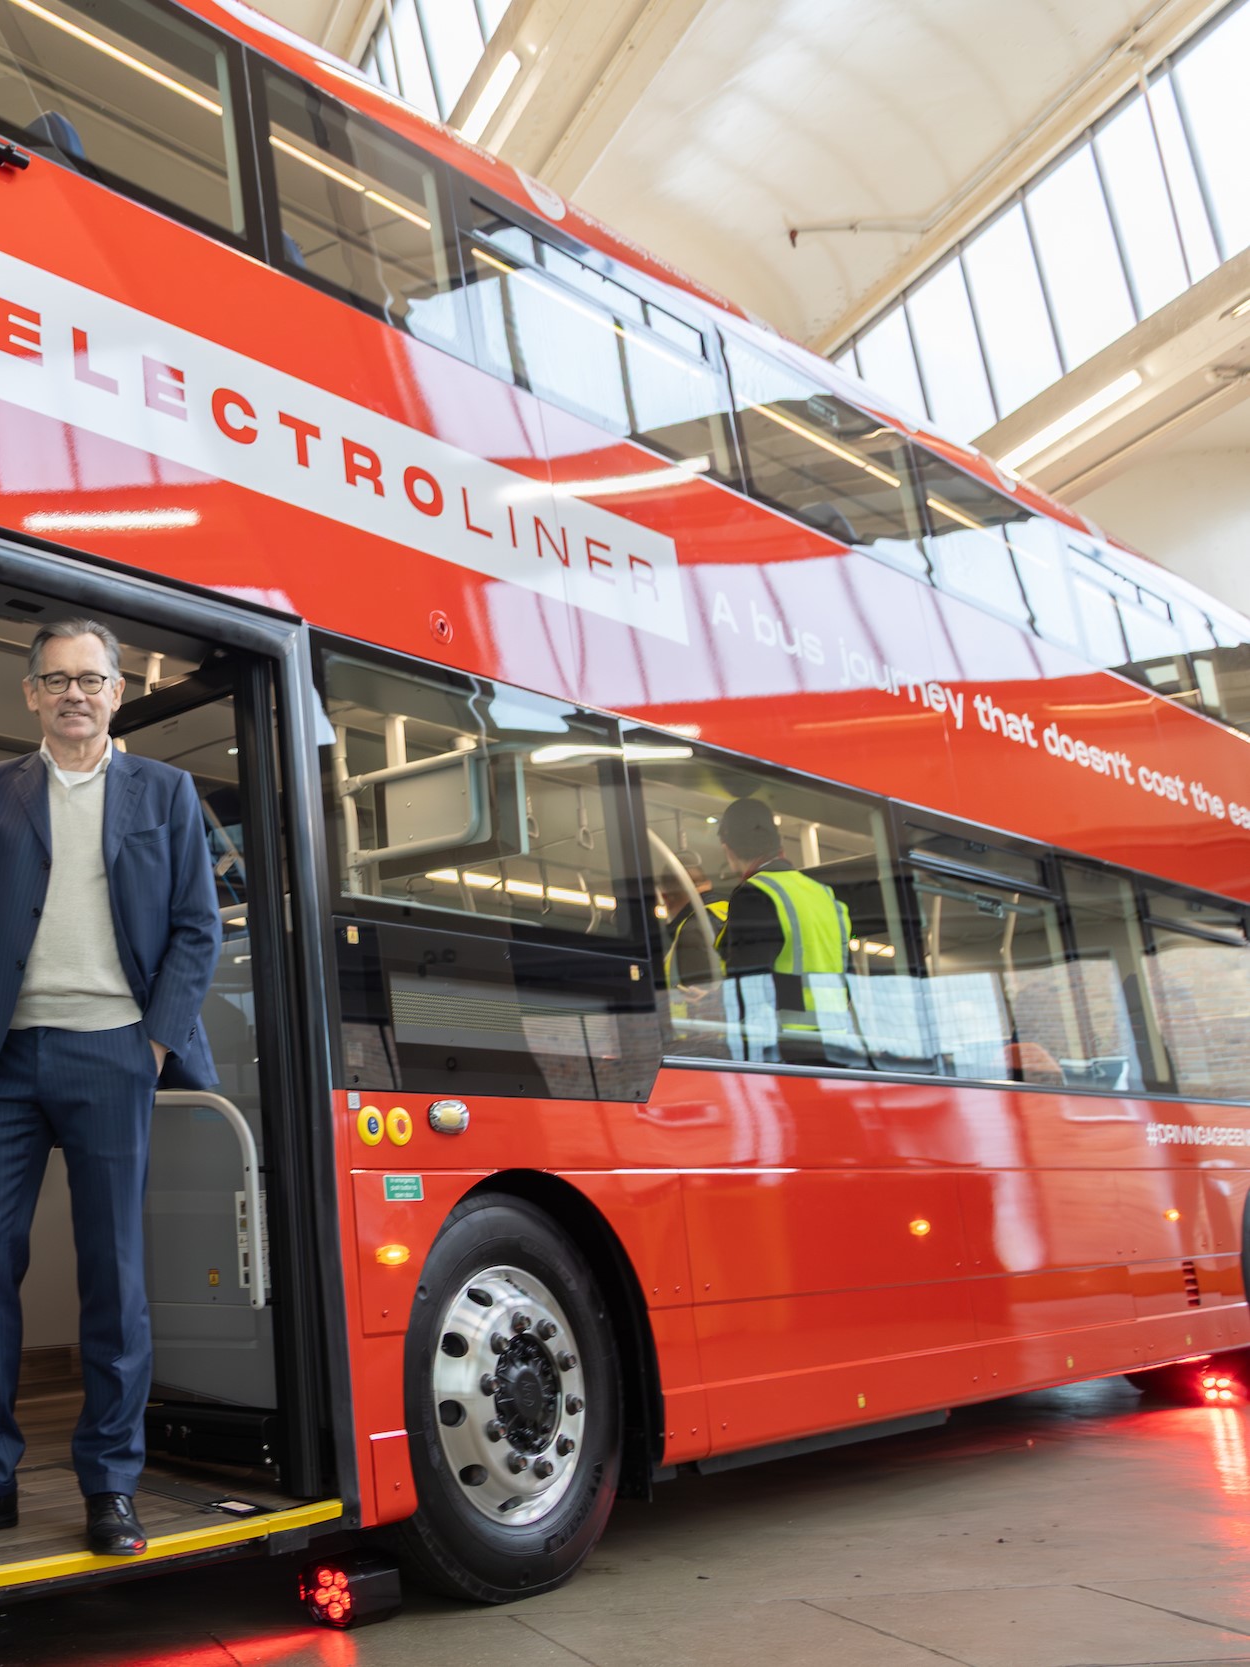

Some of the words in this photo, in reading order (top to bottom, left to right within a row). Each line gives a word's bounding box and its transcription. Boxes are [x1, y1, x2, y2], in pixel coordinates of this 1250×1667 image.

[712, 591, 740, 634] A
[751, 600, 825, 665] bus
[839, 636, 963, 730] journey
[973, 694, 1038, 748] that
[1043, 722, 1135, 785] doesn't
[1138, 766, 1188, 806] cost
[1189, 781, 1225, 819] the
